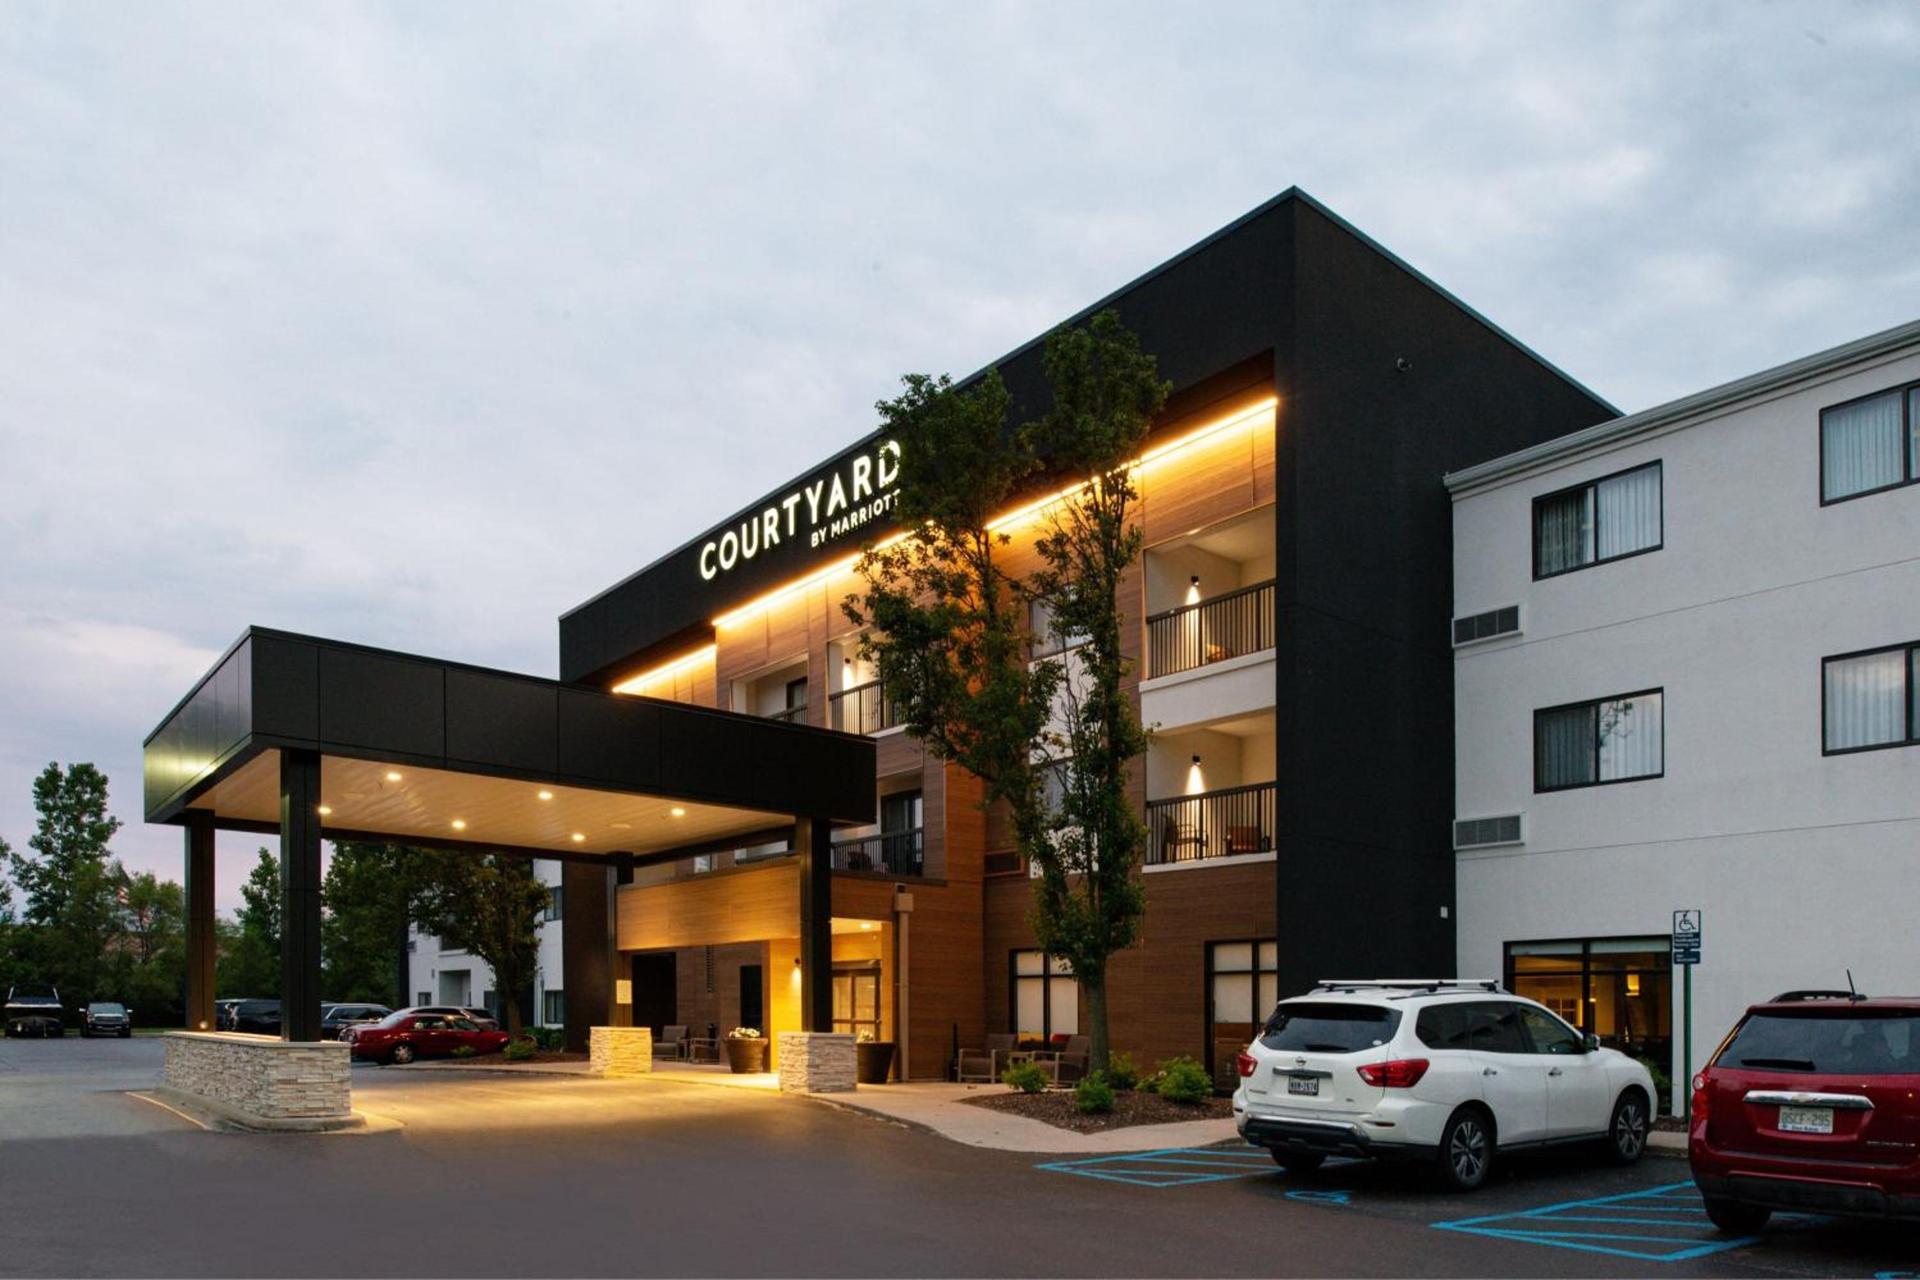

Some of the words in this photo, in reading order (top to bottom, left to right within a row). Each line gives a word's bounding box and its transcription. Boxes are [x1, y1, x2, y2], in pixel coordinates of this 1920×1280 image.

[700, 440, 901, 580] COURTYARD
[811, 528, 827, 548] BY
[831, 488, 901, 539] MARRIOTT
